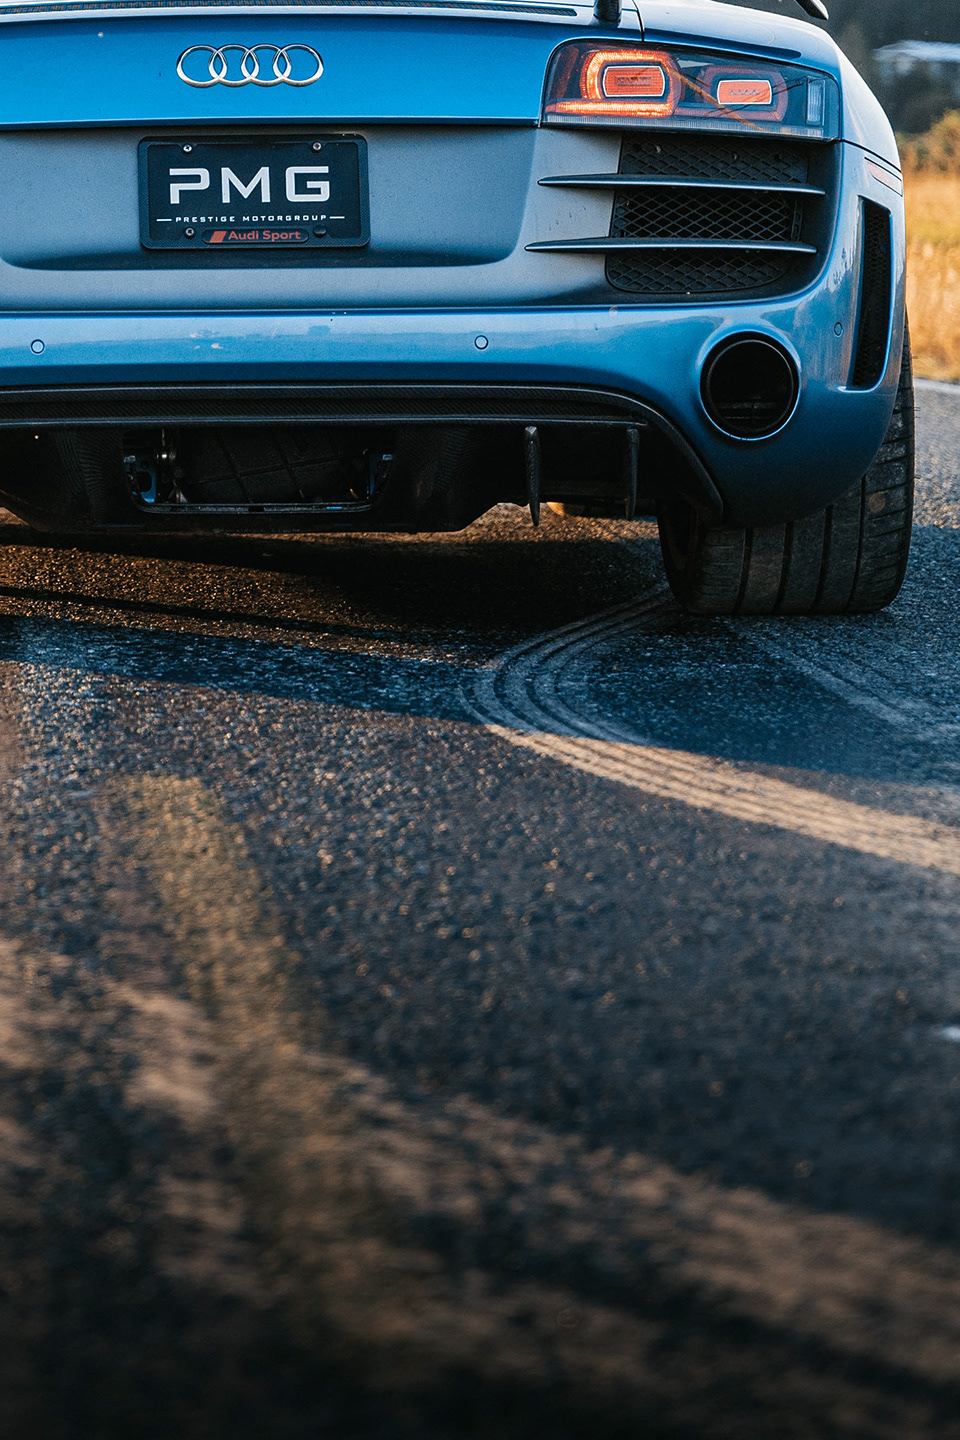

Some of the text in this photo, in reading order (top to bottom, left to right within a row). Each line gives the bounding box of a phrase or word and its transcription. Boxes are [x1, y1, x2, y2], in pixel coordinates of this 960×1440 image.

[169, 165, 330, 205] PMG
[175, 214, 327, 223] PRESTIGE MOTORGROUP
[228, 230, 302, 242] Audi Sport
